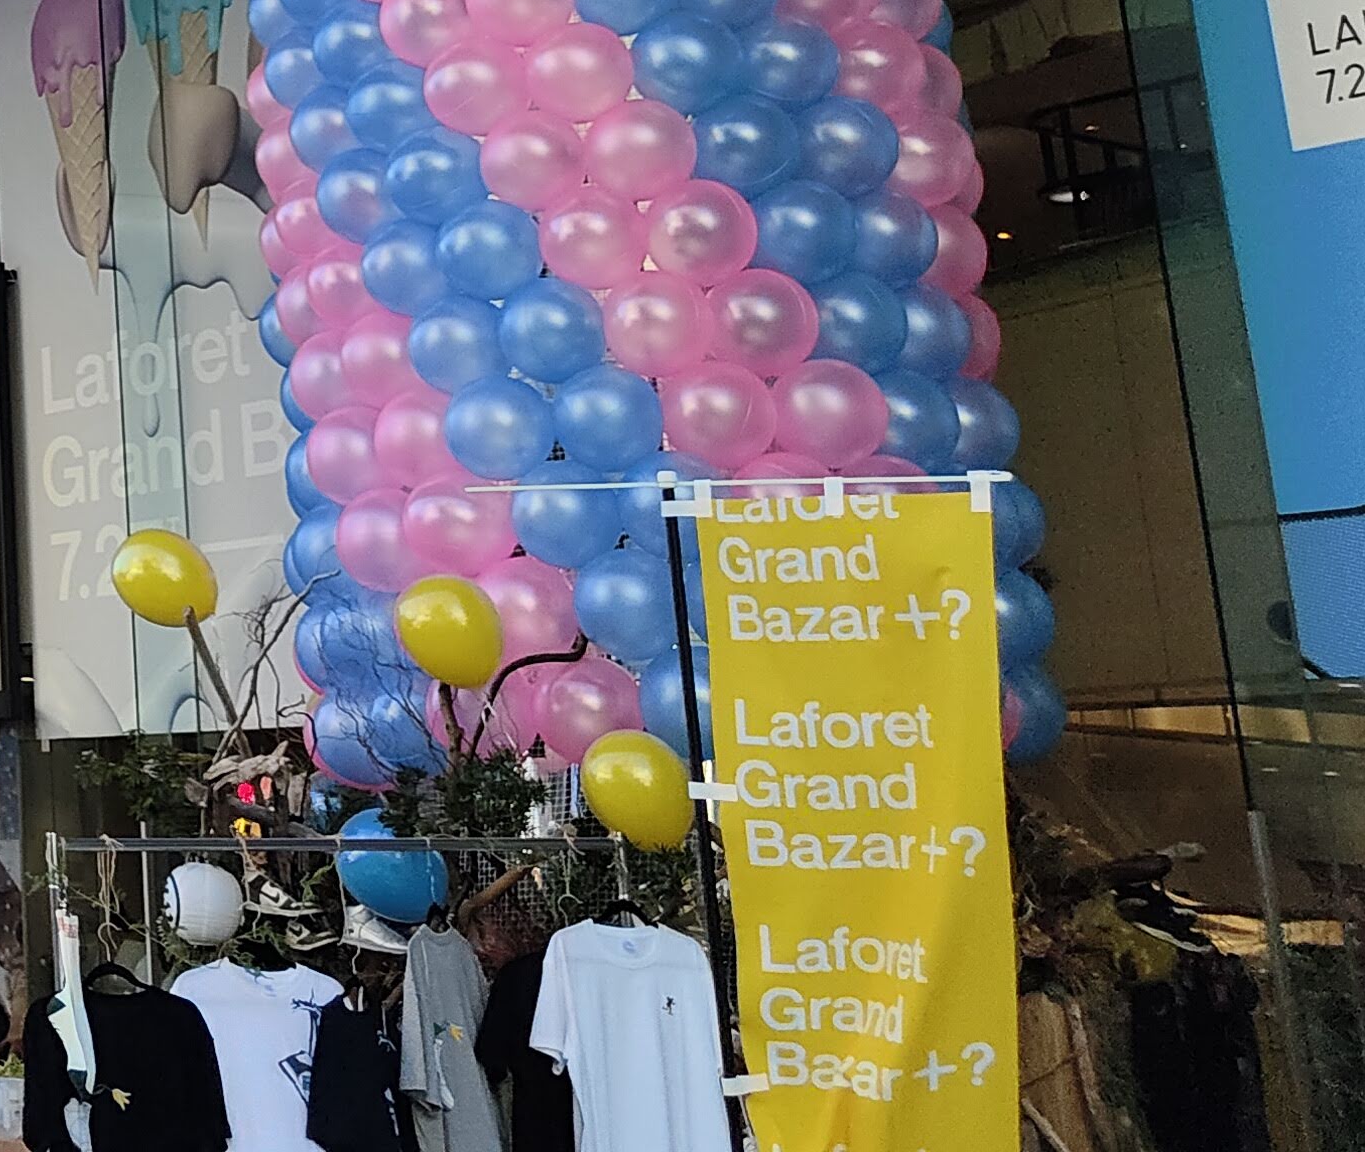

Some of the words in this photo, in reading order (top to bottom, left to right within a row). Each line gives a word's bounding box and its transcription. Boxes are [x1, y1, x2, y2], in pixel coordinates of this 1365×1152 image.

[1307, 10, 1365, 56] LA
[41, 311, 251, 415] Laforet
[43, 408, 225, 507] Grand
[241, 399, 287, 478] B
[719, 534, 880, 583] Grand
[727, 594, 884, 642] Bazar
[734, 698, 934, 748] Laforet
[735, 759, 917, 810] Grand
[745, 819, 916, 871] Bazar
[759, 924, 928, 984] Laforet
[760, 986, 903, 1044] Grand
